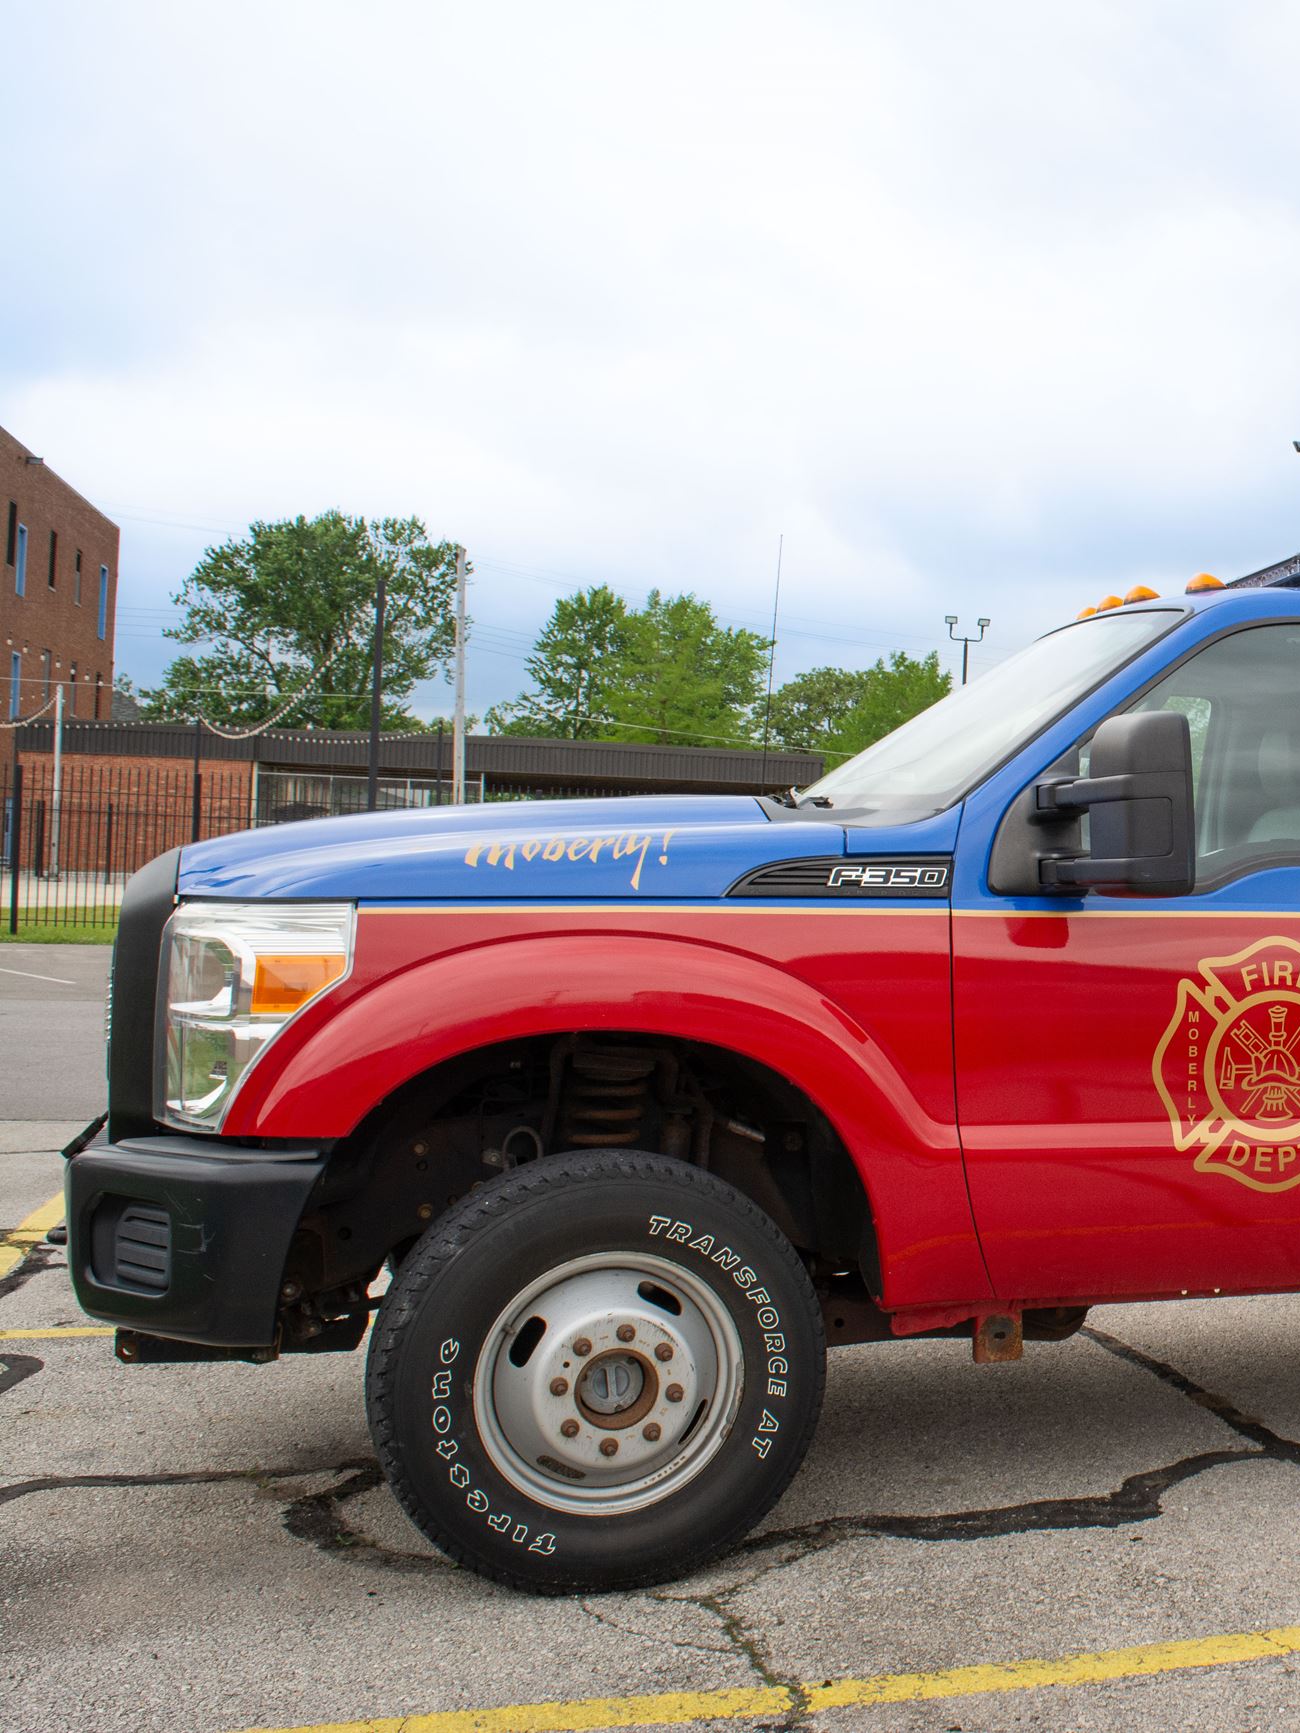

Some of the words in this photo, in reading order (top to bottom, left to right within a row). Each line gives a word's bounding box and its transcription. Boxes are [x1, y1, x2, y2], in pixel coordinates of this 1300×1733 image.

[827, 867, 947, 887] F-350
[1187, 1010, 1199, 1126] MOBERLY
[648, 1215, 788, 1398] TRANSFORCE
[752, 1409, 780, 1459] AT
[432, 1338, 557, 1556] Firestone
